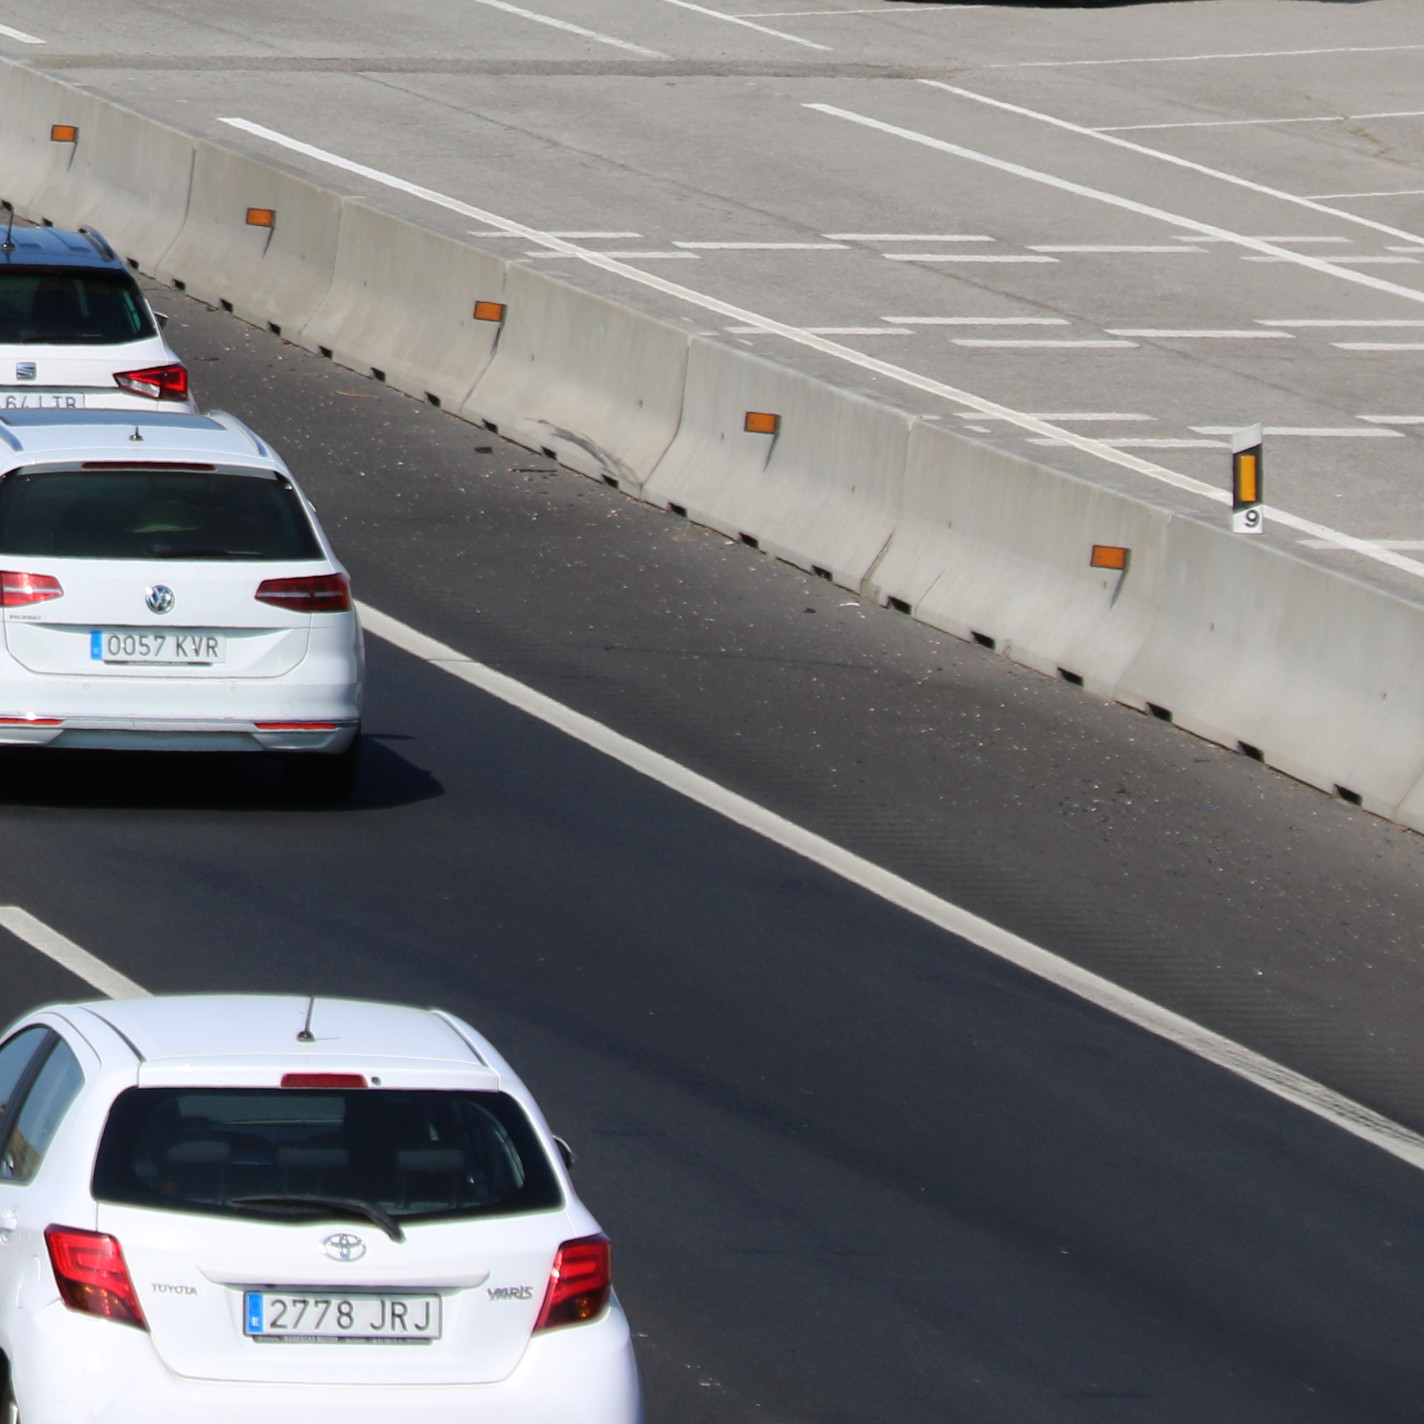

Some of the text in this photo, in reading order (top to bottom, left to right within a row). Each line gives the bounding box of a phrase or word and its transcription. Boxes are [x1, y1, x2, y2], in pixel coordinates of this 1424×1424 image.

[1245, 509, 1260, 528] 9
[108, 636, 218, 658] 0057 KVR
[151, 1283, 198, 1296] TOYOTA
[270, 1299, 354, 1330] 2778
[370, 1300, 430, 1331] JRJ
